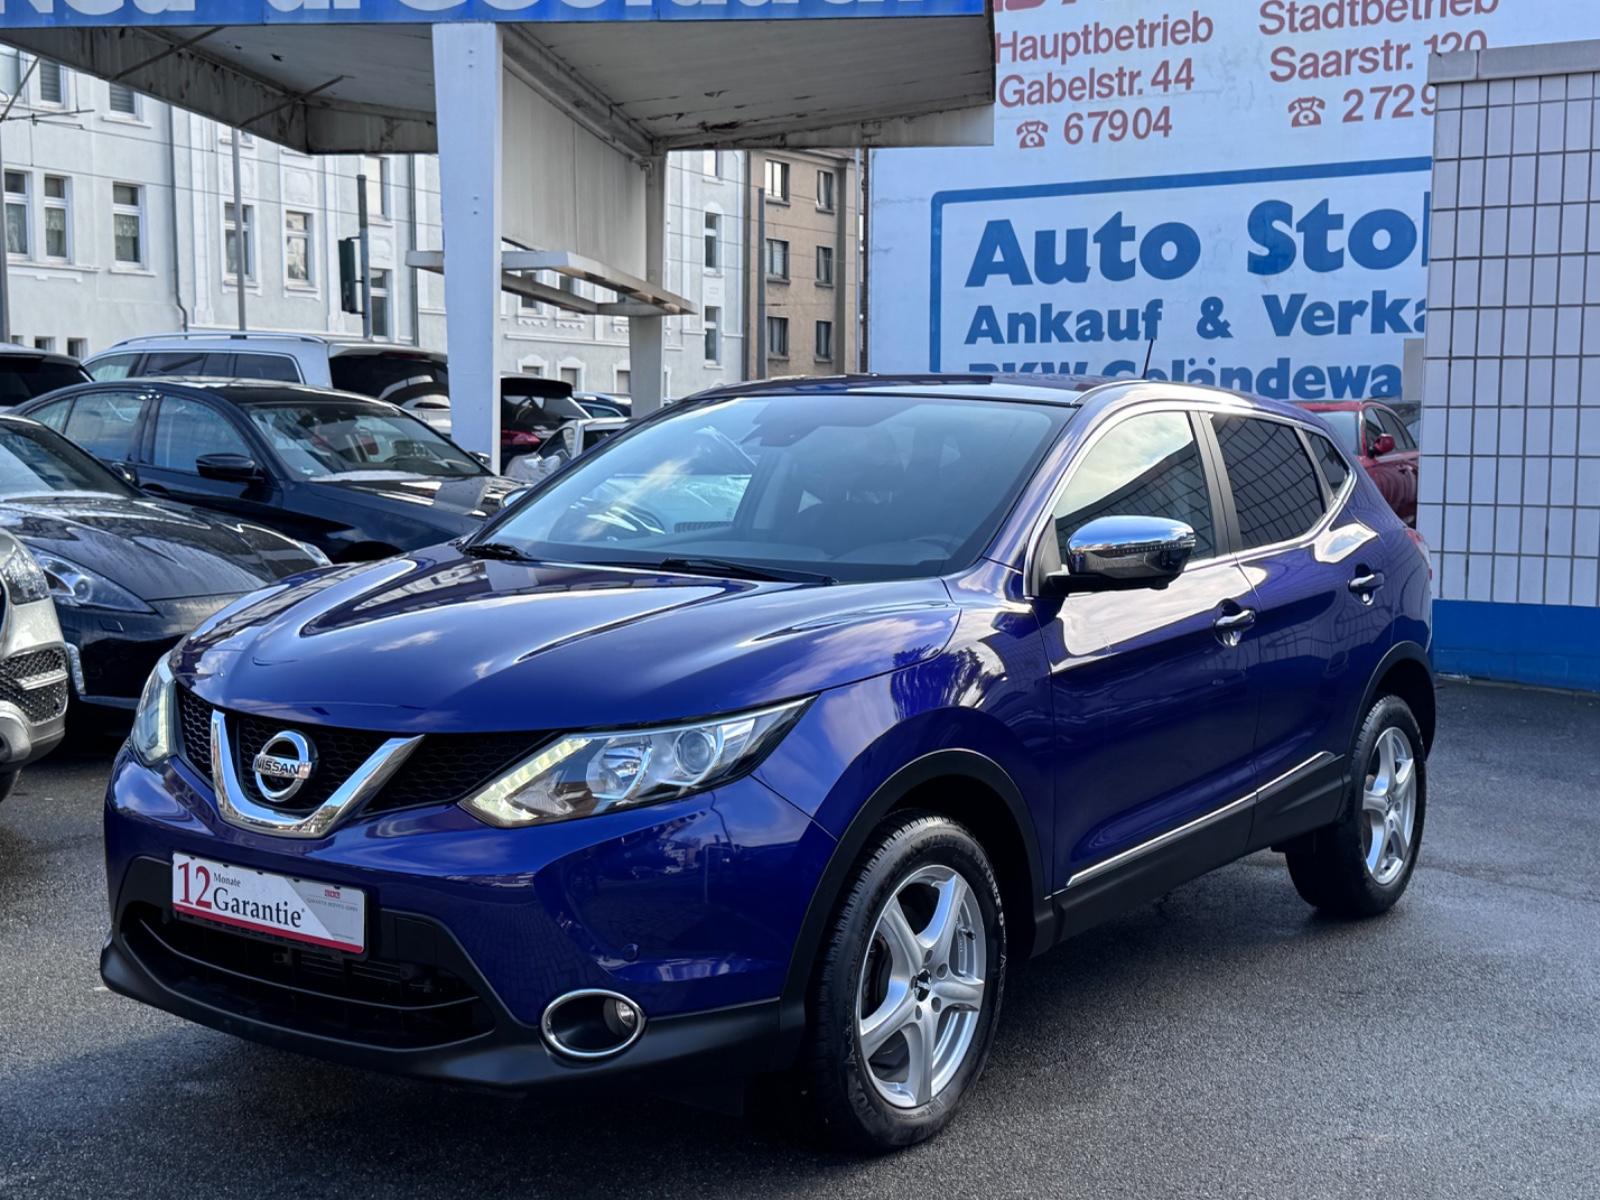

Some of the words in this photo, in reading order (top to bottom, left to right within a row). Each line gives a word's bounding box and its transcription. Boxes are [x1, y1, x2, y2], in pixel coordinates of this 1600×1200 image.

[995, 10, 1213, 65] Hauptbetrieb
[1270, 39, 1413, 82] Saarstr.
[1423, 29, 1488, 53] 120
[999, 66, 1143, 107] Gabelstr.
[1151, 58, 1194, 92] 44
[1064, 106, 1172, 145] 67904
[964, 211, 1201, 288] Auto
[1247, 191, 1431, 275] Sto
[964, 299, 1163, 345] Ankauf
[1196, 296, 1234, 340] &
[257, 756, 300, 775] NISSAN
[178, 862, 213, 910] 12
[213, 872, 241, 887] Monate
